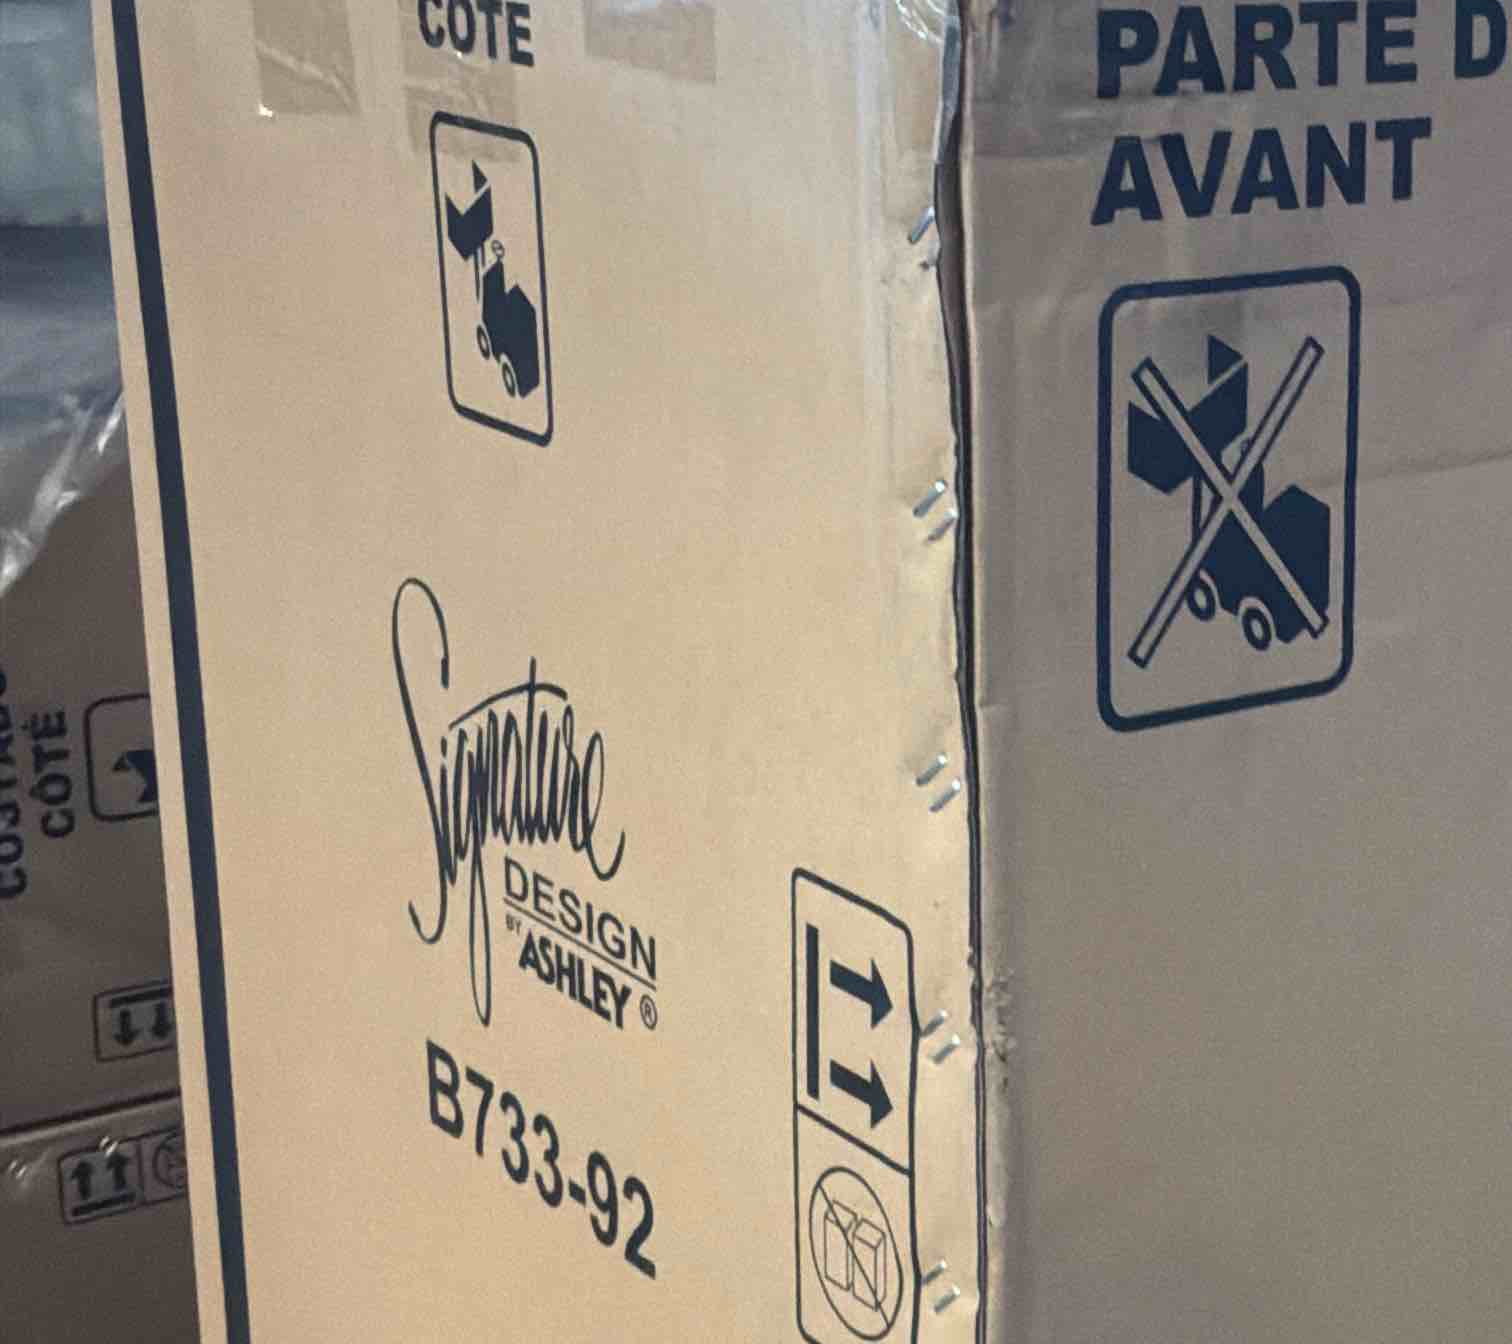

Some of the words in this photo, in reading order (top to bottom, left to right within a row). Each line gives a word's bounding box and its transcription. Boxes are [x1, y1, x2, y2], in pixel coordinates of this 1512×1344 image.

[1090, 116, 1433, 226] AVANT
[392, 578, 625, 1027] Signature
[504, 853, 657, 981] DESIGN
[518, 927, 632, 1030] ASHLEY
[426, 1038, 657, 1280] B733-92
